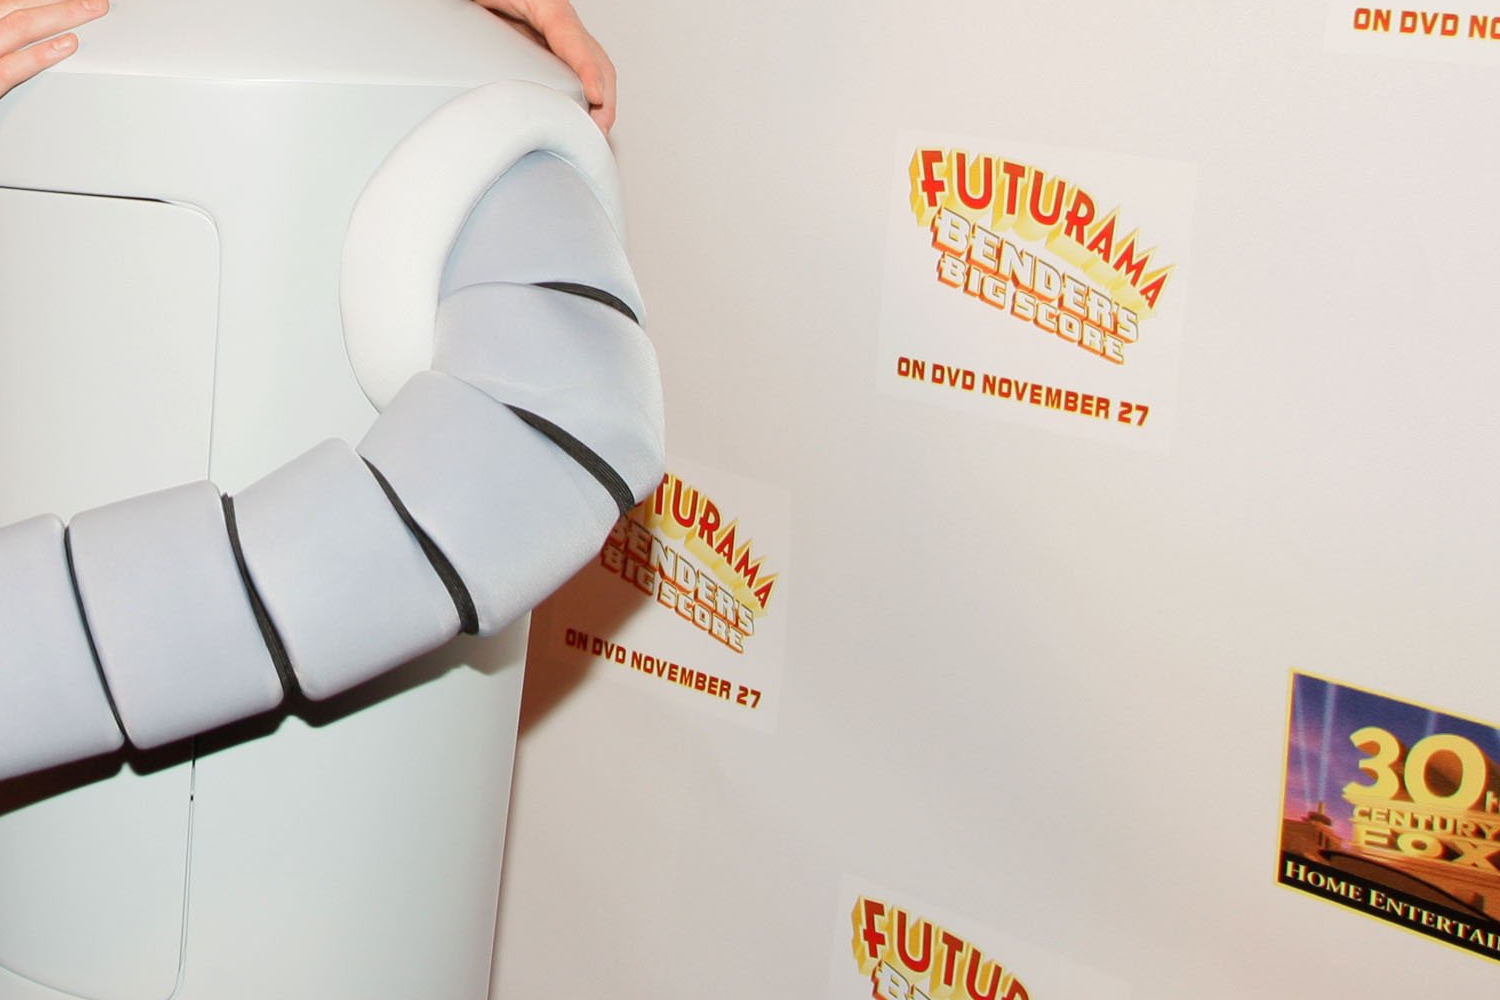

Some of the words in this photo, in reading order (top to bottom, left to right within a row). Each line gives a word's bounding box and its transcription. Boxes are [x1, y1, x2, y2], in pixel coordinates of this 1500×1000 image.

[1353, 7, 1391, 32] ON
[1399, 10, 1459, 37] DVD
[920, 149, 1168, 310] FUTURAMA
[931, 205, 1139, 344] BENDER'S
[937, 250, 1008, 310] BIG
[1011, 289, 1125, 366] SCORE
[897, 356, 925, 381] ON
[931, 363, 976, 391] DVD
[981, 373, 1111, 420] NOVEMBER
[1117, 401, 1150, 427] 27
[653, 473, 775, 610] TURAMA
[601, 541, 655, 597] BIG
[656, 580, 744, 655] SCORE
[565, 627, 589, 652] ON
[591, 637, 627, 664] DVD
[630, 650, 732, 701] NOVEMBER
[736, 685, 762, 709] 27
[1352, 803, 1500, 842] CENTURY
[1284, 859, 1363, 902] HOME
